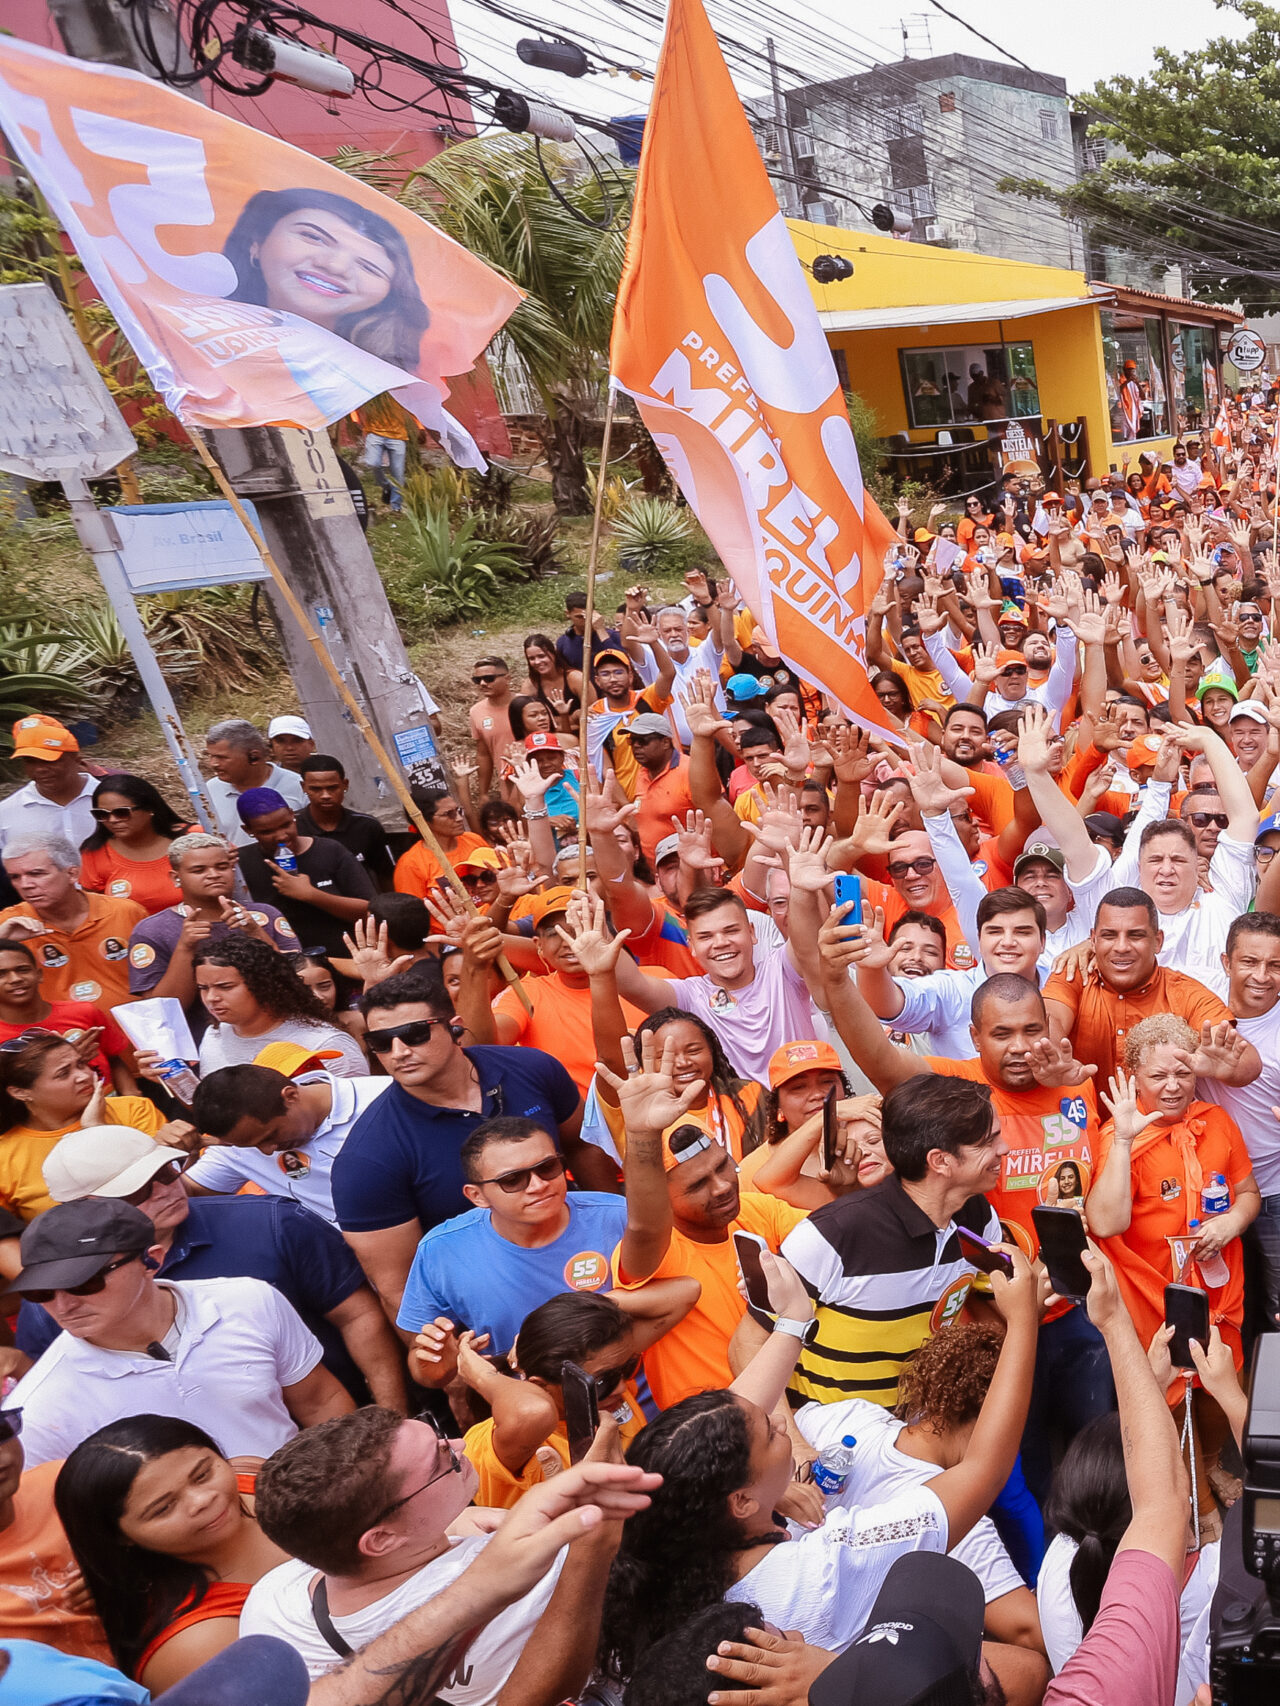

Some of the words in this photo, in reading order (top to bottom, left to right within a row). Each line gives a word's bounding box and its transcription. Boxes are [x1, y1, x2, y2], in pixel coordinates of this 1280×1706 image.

[178, 530, 224, 545] Brasil
[954, 944, 971, 957] 55
[75, 983, 94, 996] 55
[523, 1105, 541, 1117] BOSS
[1067, 1099, 1087, 1123] 45
[1043, 1115, 1080, 1144] 55
[573, 1258, 598, 1279] 55
[942, 1283, 970, 1317] 55
